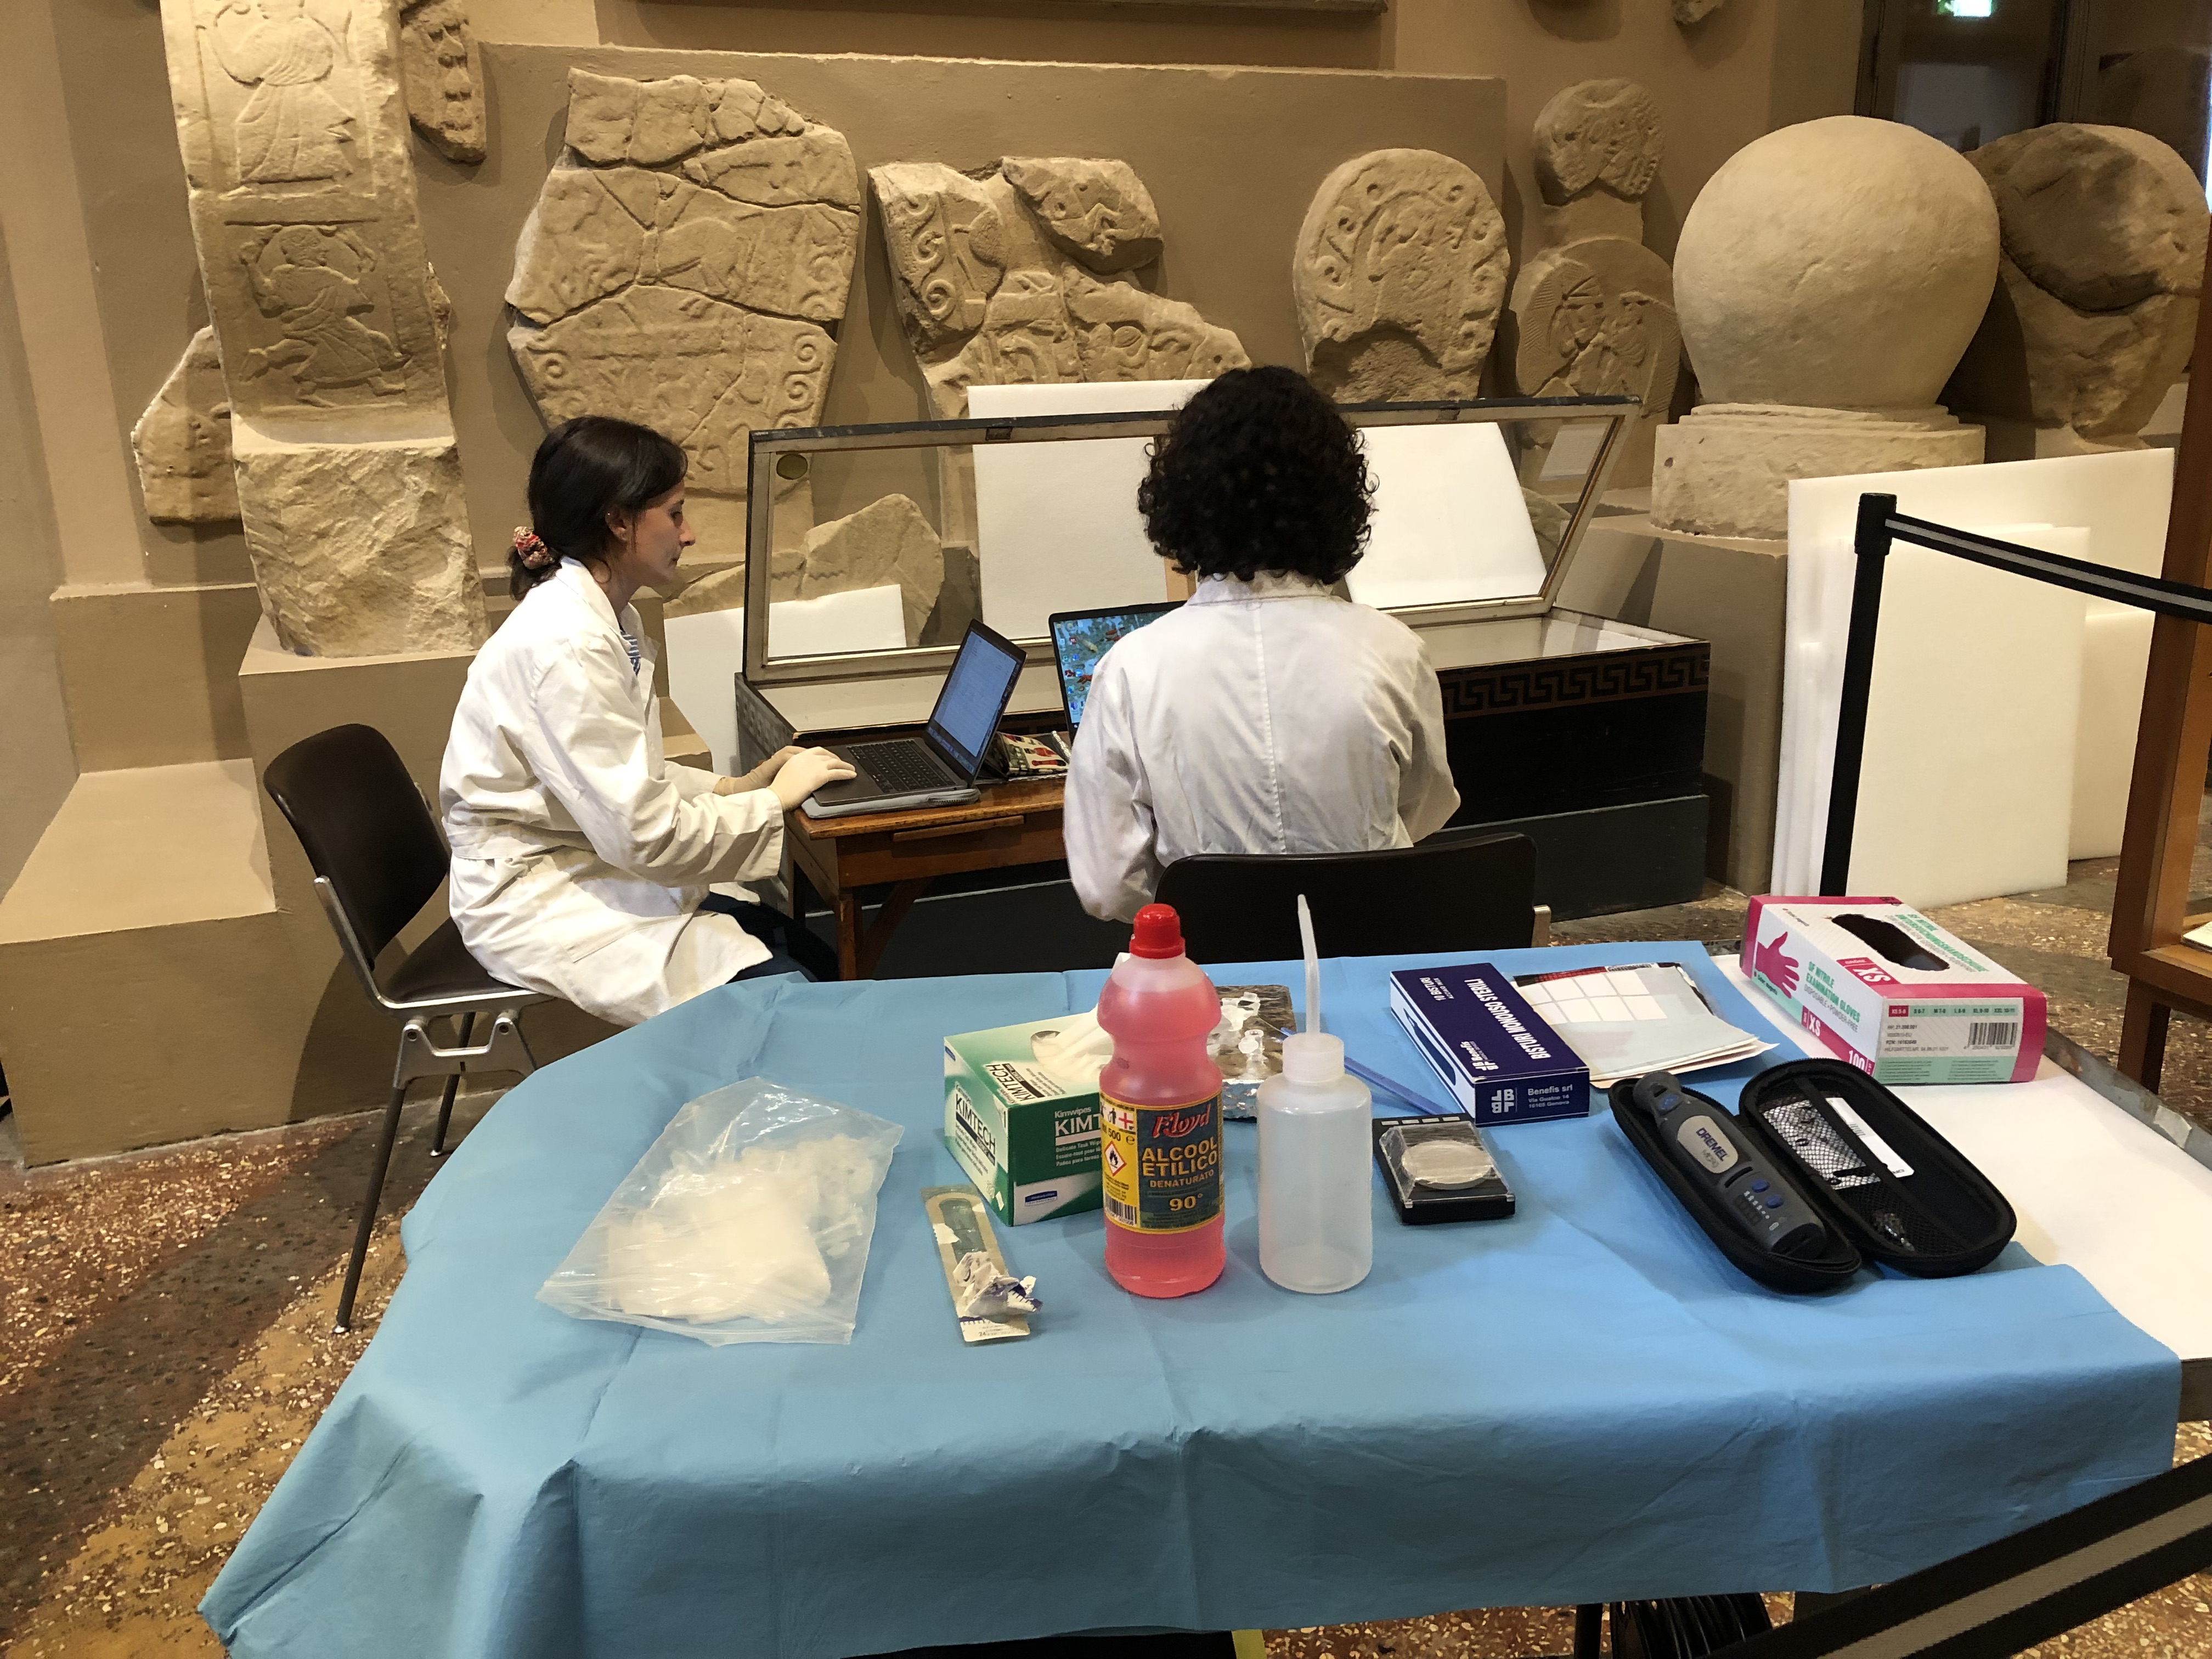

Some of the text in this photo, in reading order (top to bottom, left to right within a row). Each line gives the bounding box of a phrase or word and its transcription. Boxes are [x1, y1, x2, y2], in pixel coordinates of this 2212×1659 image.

[1853, 967, 1891, 982] XS
[1419, 977, 1442, 996] BISTURI
[1464, 978, 1499, 1002] STERILI
[1484, 1001, 1527, 1034] MONOUSO
[1839, 1000, 1860, 1023] GLOVES
[1809, 1014, 1821, 1037] XS
[1511, 1032, 1551, 1059] BISTURI
[1848, 1050, 1865, 1070] 100
[986, 1064, 1036, 1102] KIMTECH
[1528, 1086, 1559, 1096] Benefis
[956, 1094, 996, 1154] KIMTECH
[1055, 1107, 1092, 1118] Kimwipes
[1153, 1104, 1211, 1138] Floyd
[1108, 1128, 1121, 1141] 500
[1696, 1127, 1728, 1161] DREMEL
[1142, 1136, 1217, 1161] ALCOOL
[1143, 1150, 1217, 1176] ETILICO
[1150, 1170, 1214, 1188] DENATURATO
